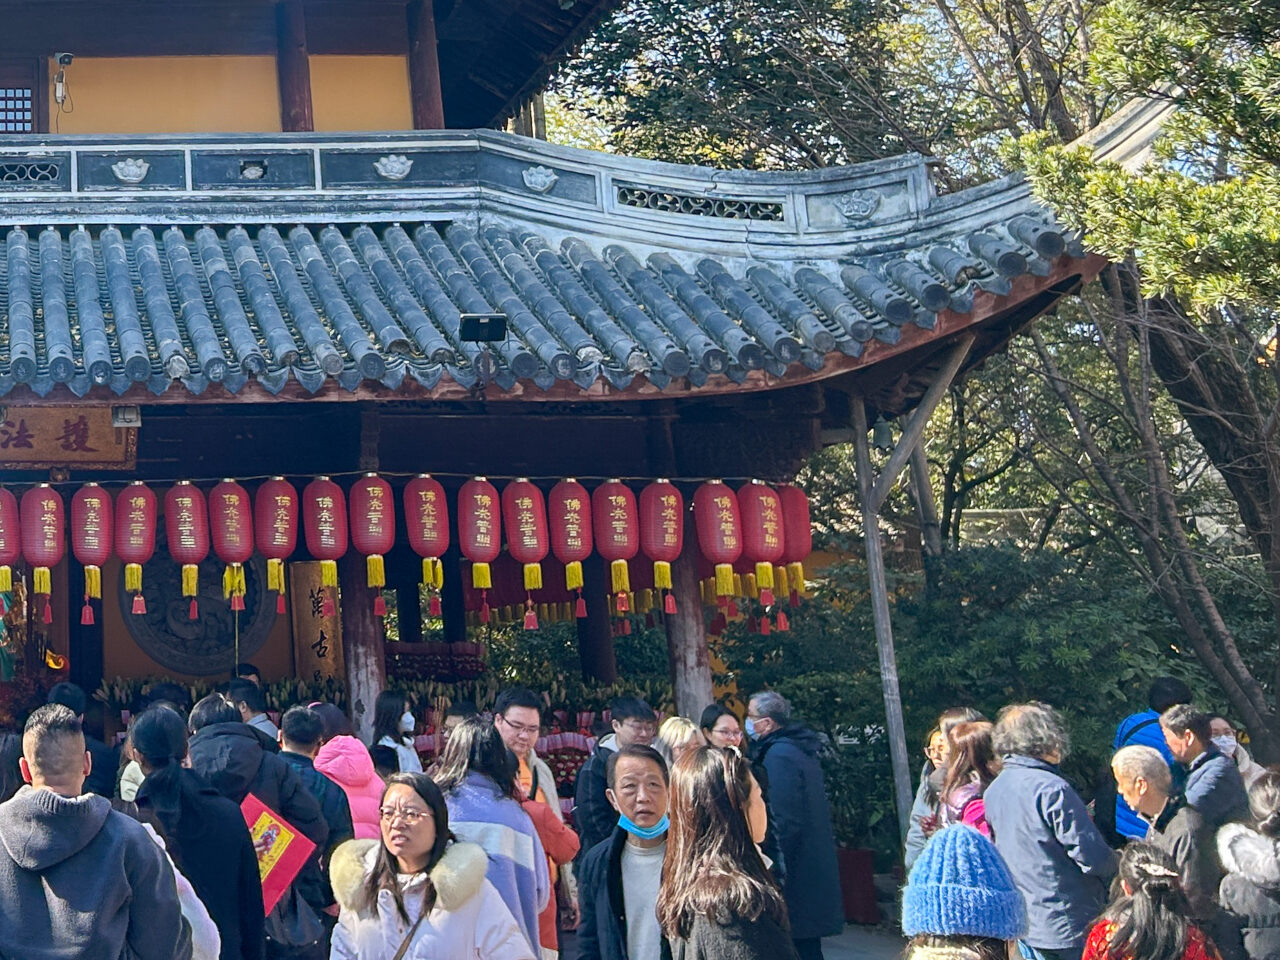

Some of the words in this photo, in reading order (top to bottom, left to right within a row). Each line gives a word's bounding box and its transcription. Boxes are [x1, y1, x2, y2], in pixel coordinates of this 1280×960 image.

[128, 496, 146, 547] 佛光普照
[272, 495, 292, 546] 佛光普照
[315, 496, 336, 547] 佛光普照
[365, 486, 384, 537] 佛光普照
[418, 490, 438, 542] 佛光普照
[473, 494, 492, 547] 佛光普照
[515, 497, 538, 548] 佛光普照
[563, 498, 582, 550] 佛光普照
[608, 495, 628, 546] 佛光普照
[660, 495, 678, 547] 佛光普照
[713, 495, 737, 549] 佛光普照
[759, 495, 778, 549] 佛光普照
[309, 587, 333, 681] 萬古
